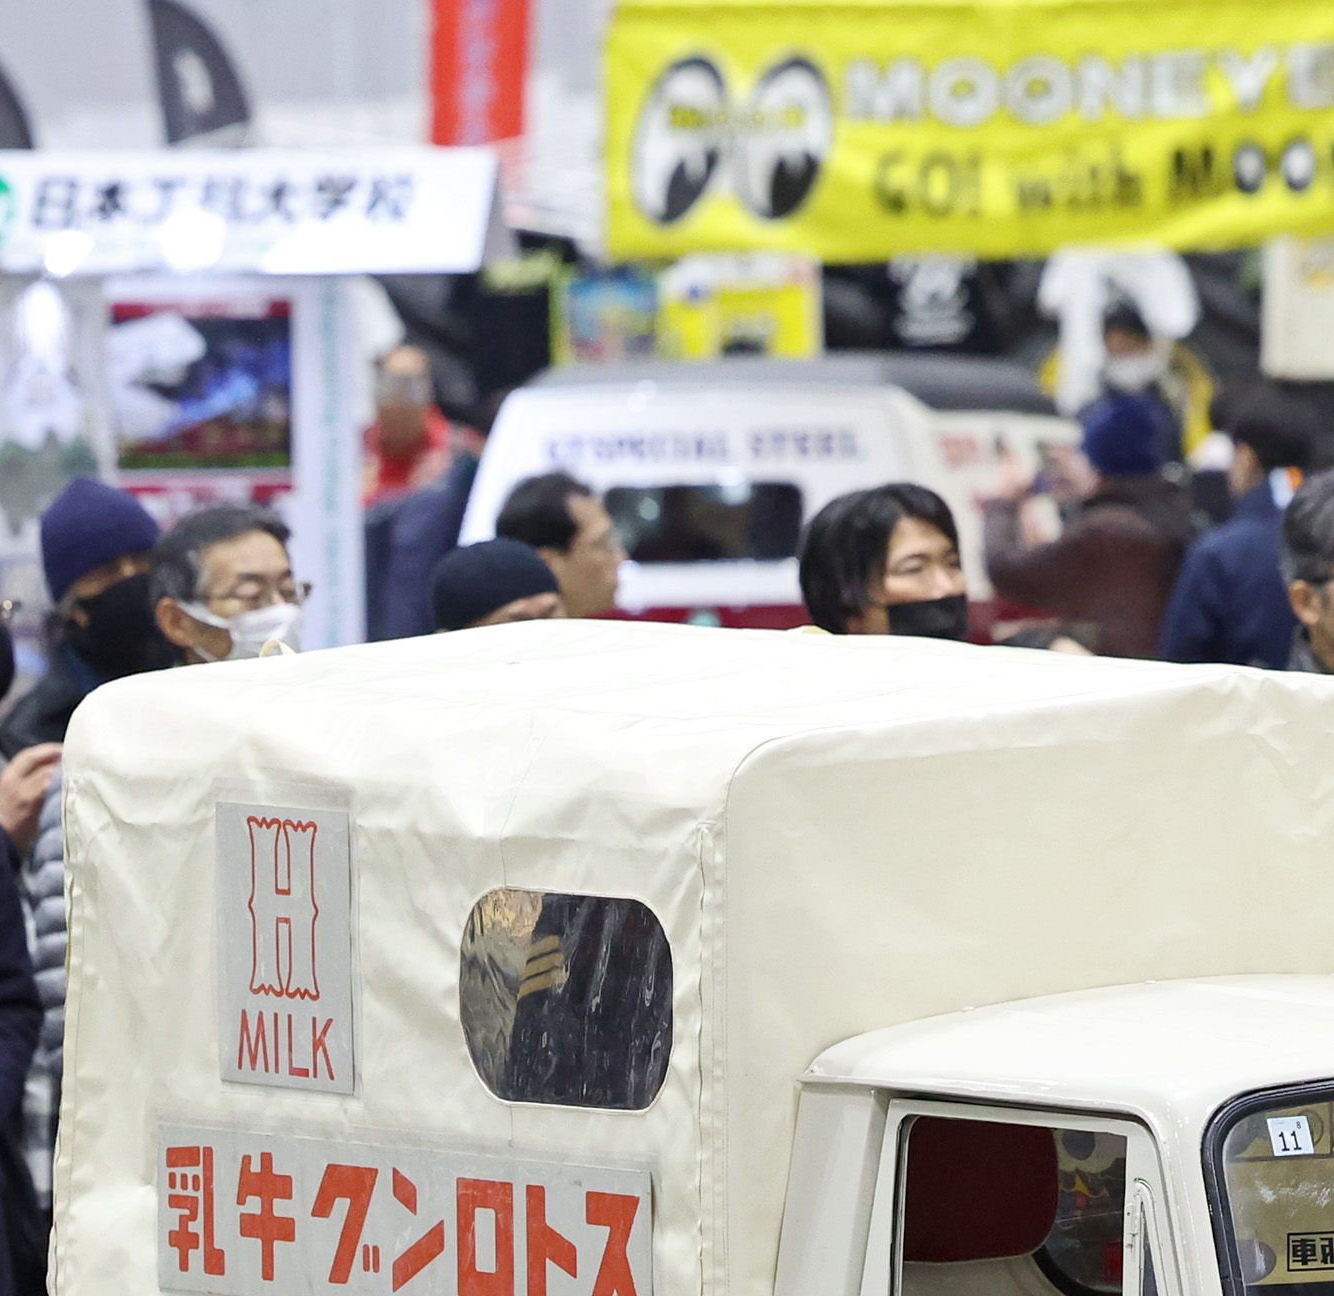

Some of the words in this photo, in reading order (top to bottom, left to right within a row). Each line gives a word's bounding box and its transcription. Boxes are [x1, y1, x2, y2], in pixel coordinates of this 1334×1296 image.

[247, 816, 319, 1000] H
[237, 1009, 334, 1080] MILK
[1278, 1130, 1302, 1152] 11
[1296, 1121, 1302, 1130] 8
